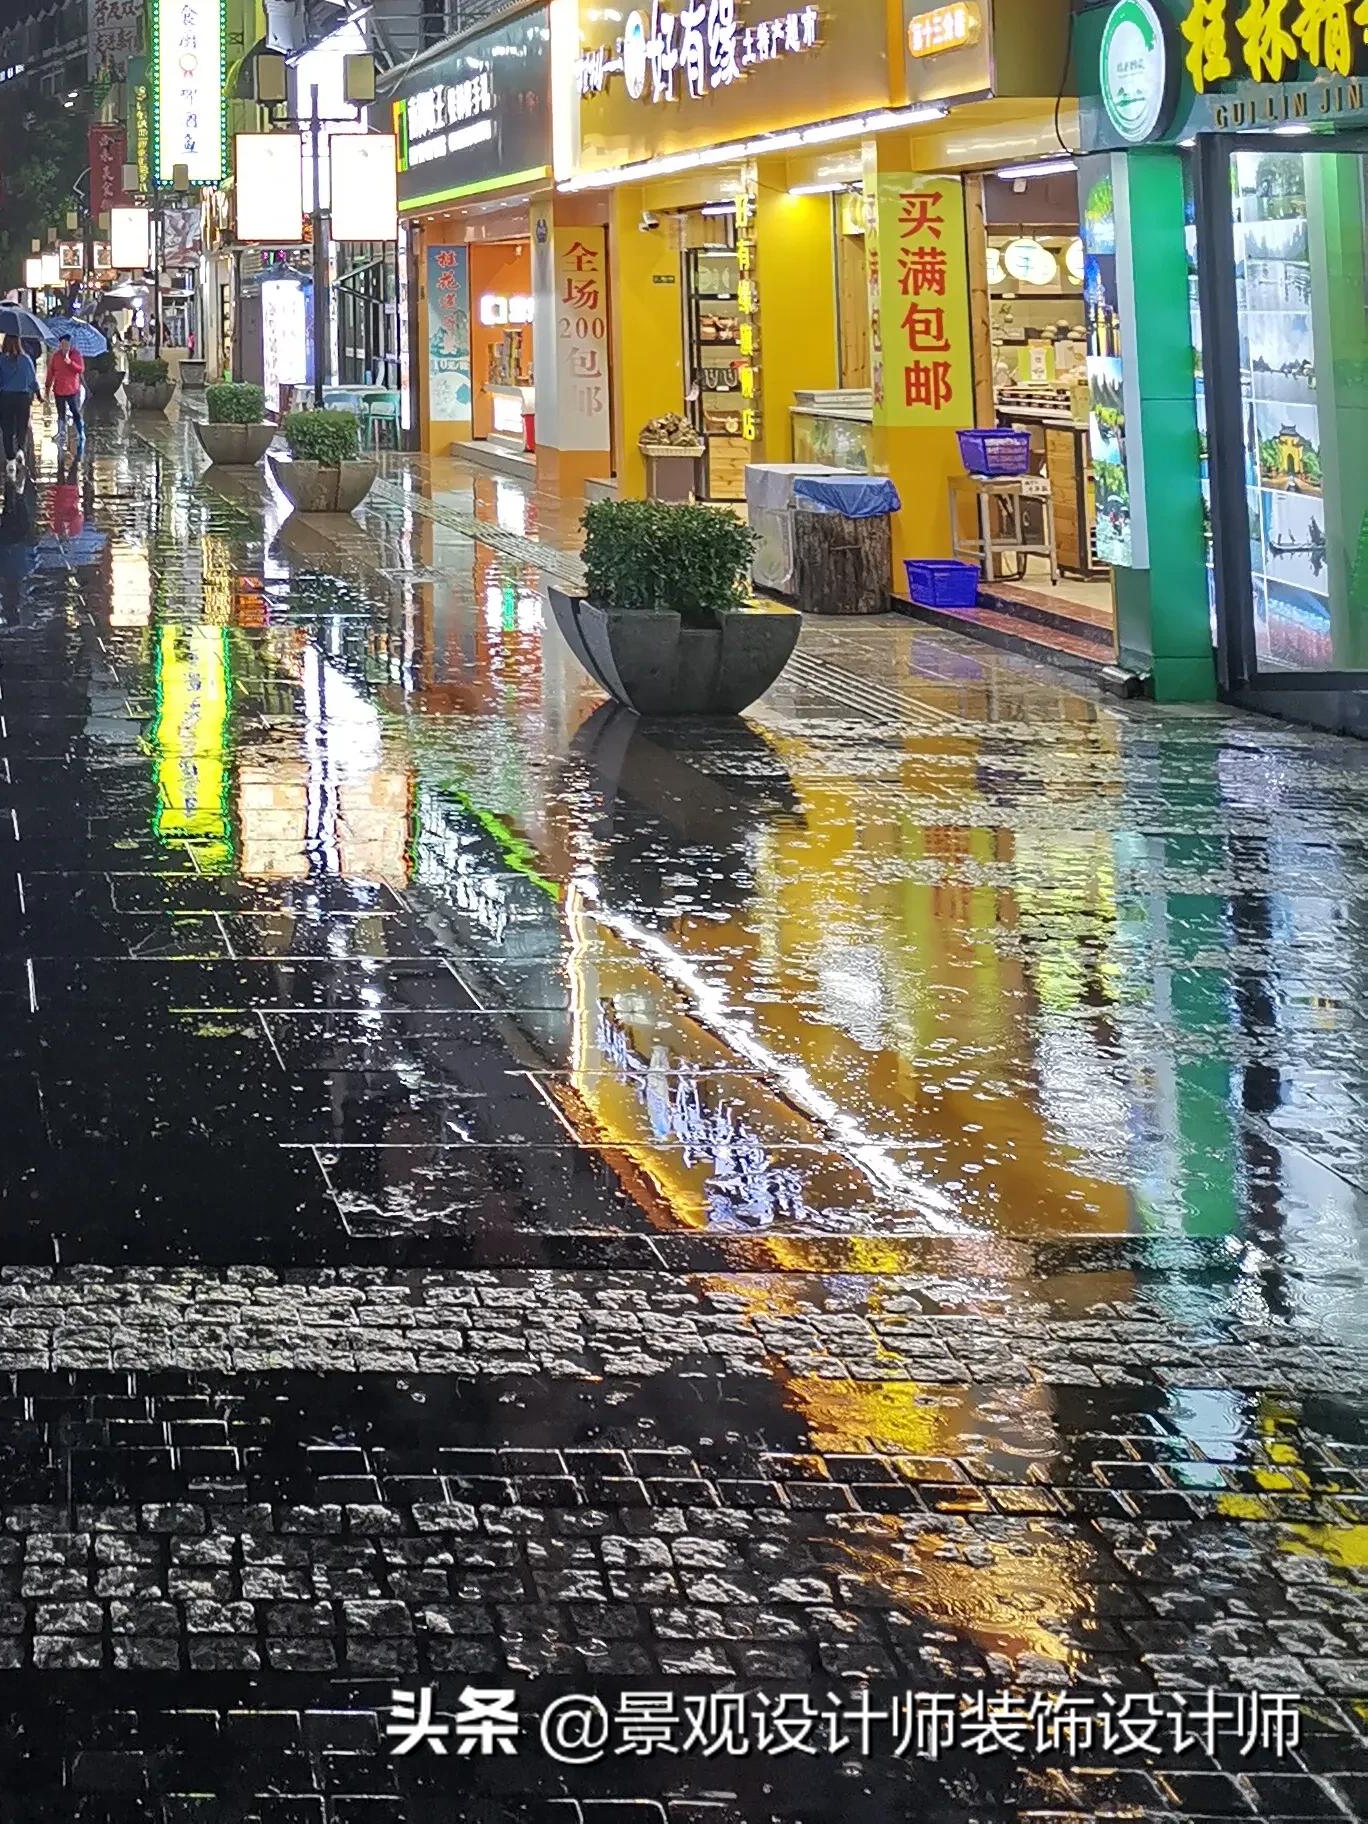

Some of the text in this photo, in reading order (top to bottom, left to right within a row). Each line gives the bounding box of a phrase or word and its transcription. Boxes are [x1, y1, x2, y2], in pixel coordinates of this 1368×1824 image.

[741, 5, 818, 66] 土特产超市
[897, 191, 953, 411] 买满包邮
